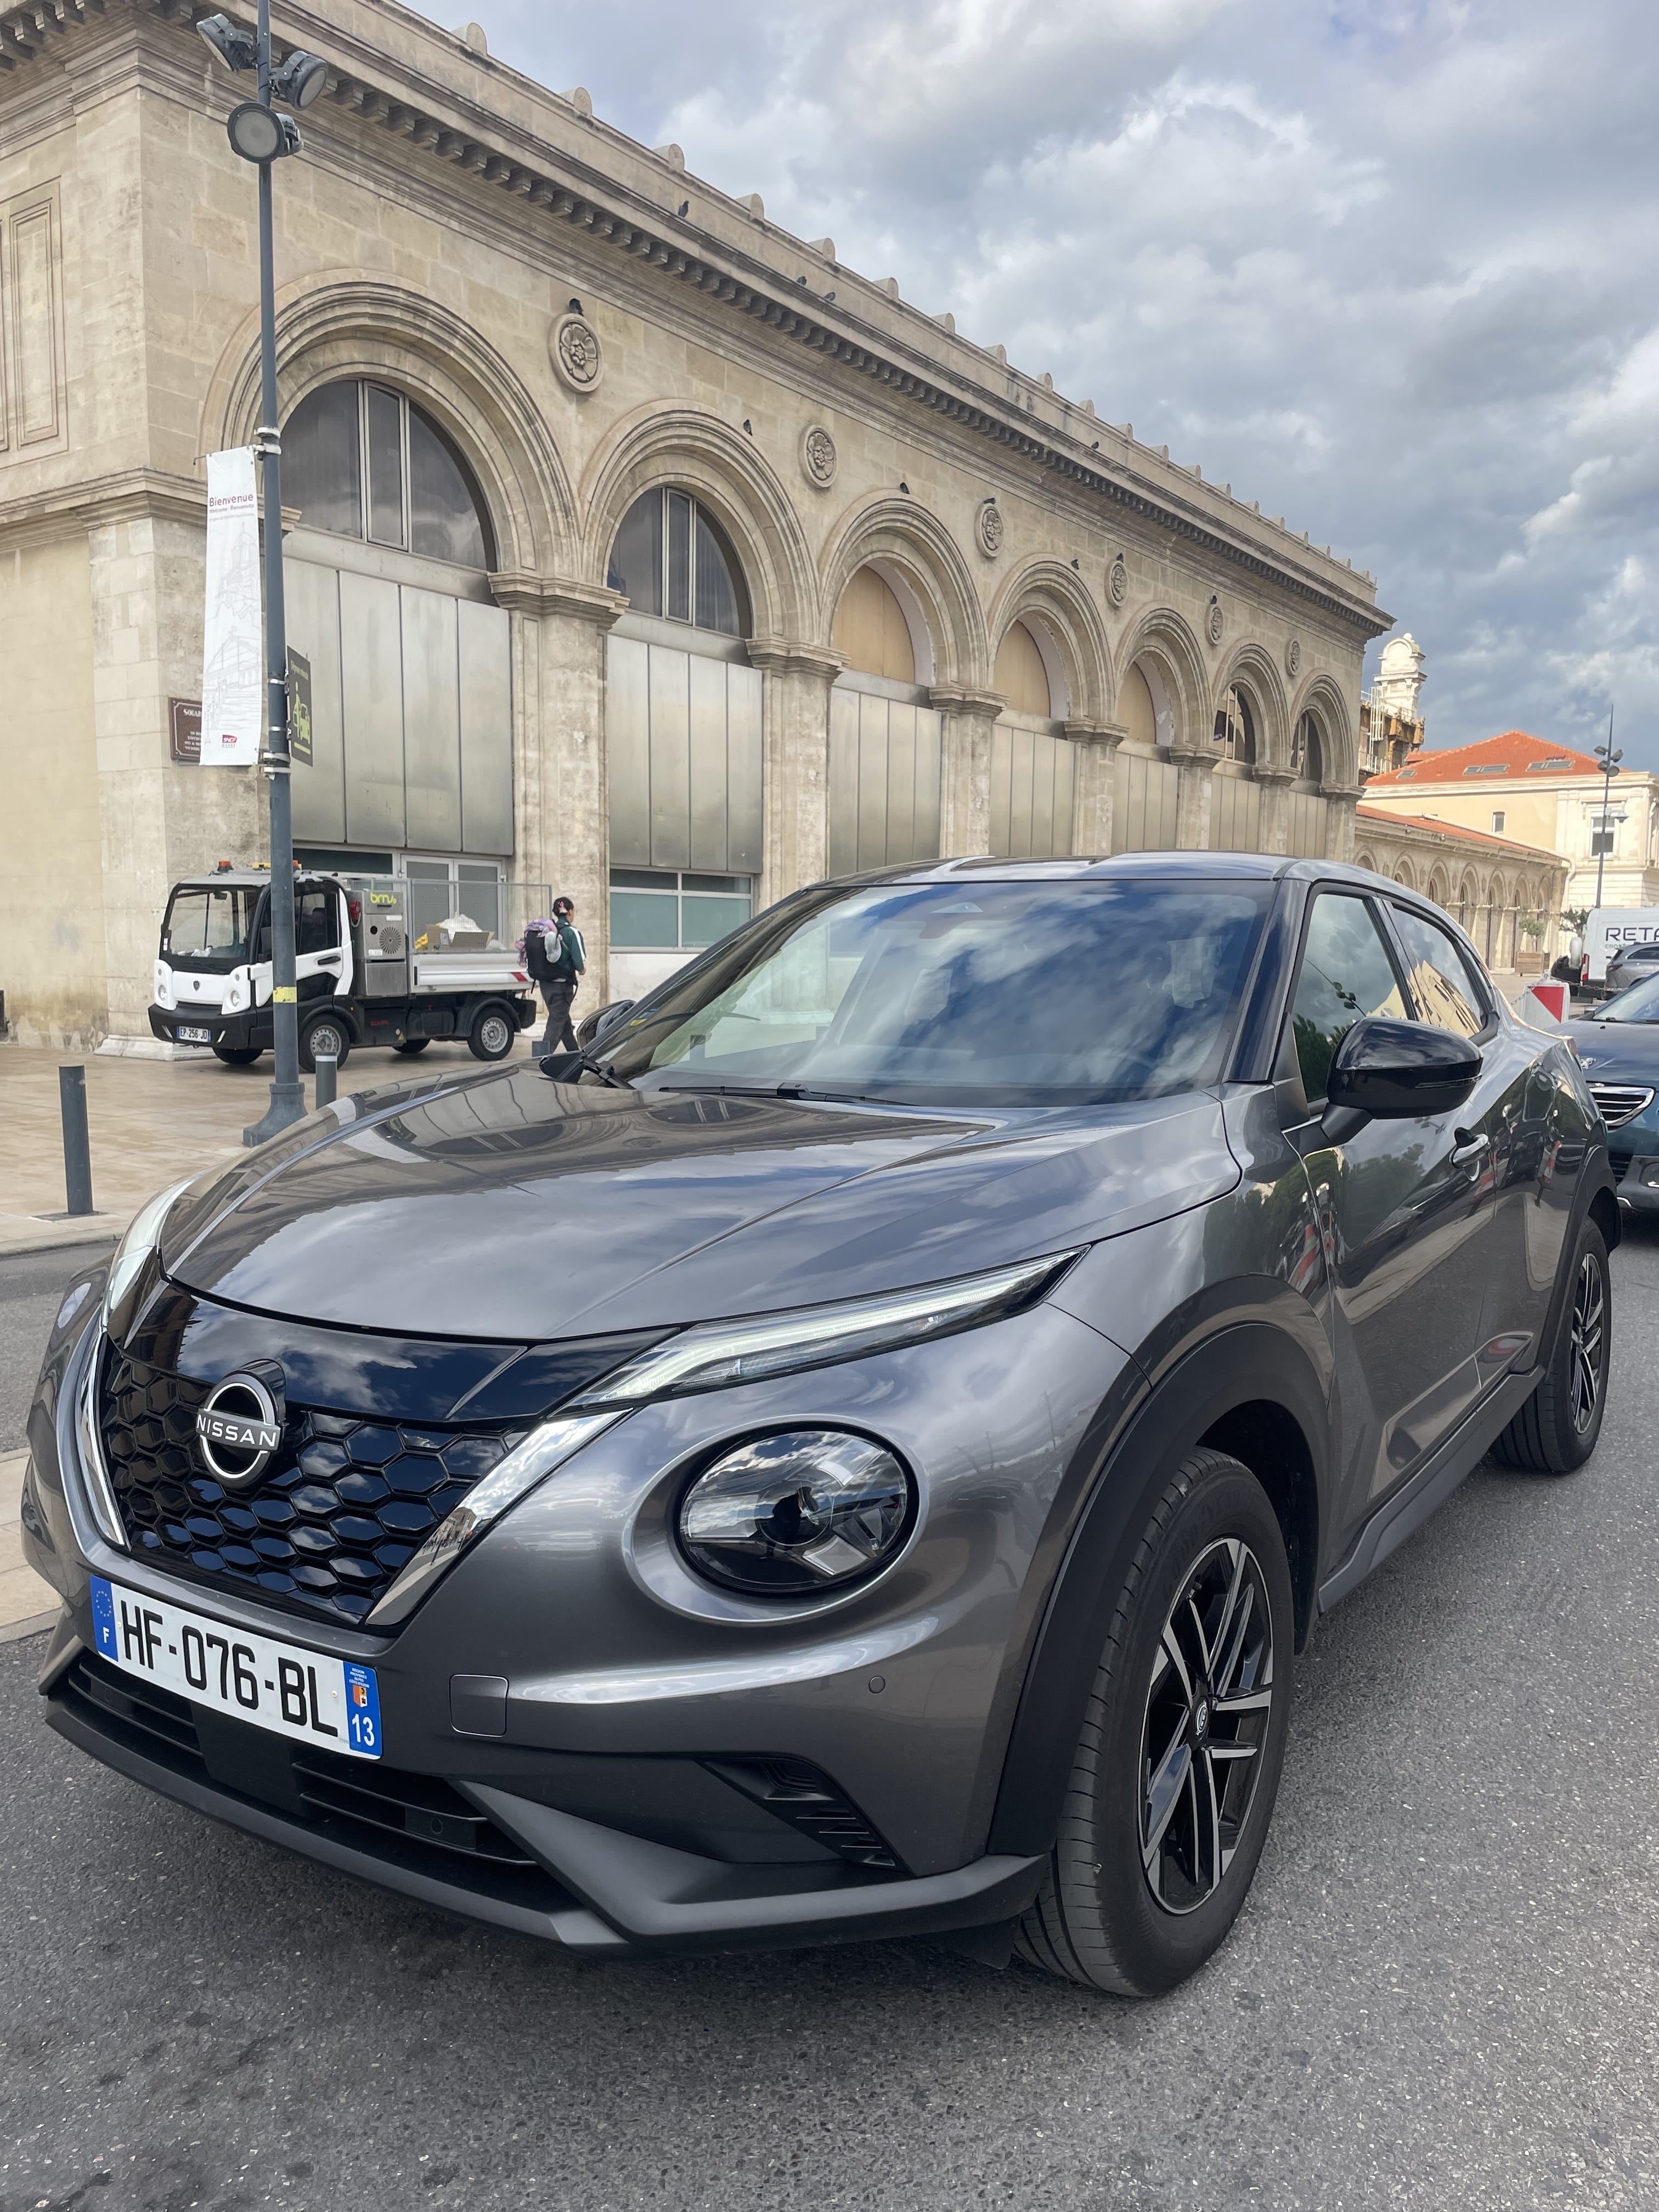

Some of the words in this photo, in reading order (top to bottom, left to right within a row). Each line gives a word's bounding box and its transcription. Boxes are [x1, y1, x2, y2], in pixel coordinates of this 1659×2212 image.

[209, 494, 253, 507] Bienvenue
[196, 1414, 276, 1447] NISSAN
[103, 1627, 109, 1644] F
[121, 1600, 338, 1737] HF-076-BL
[352, 1713, 375, 1746] 13
